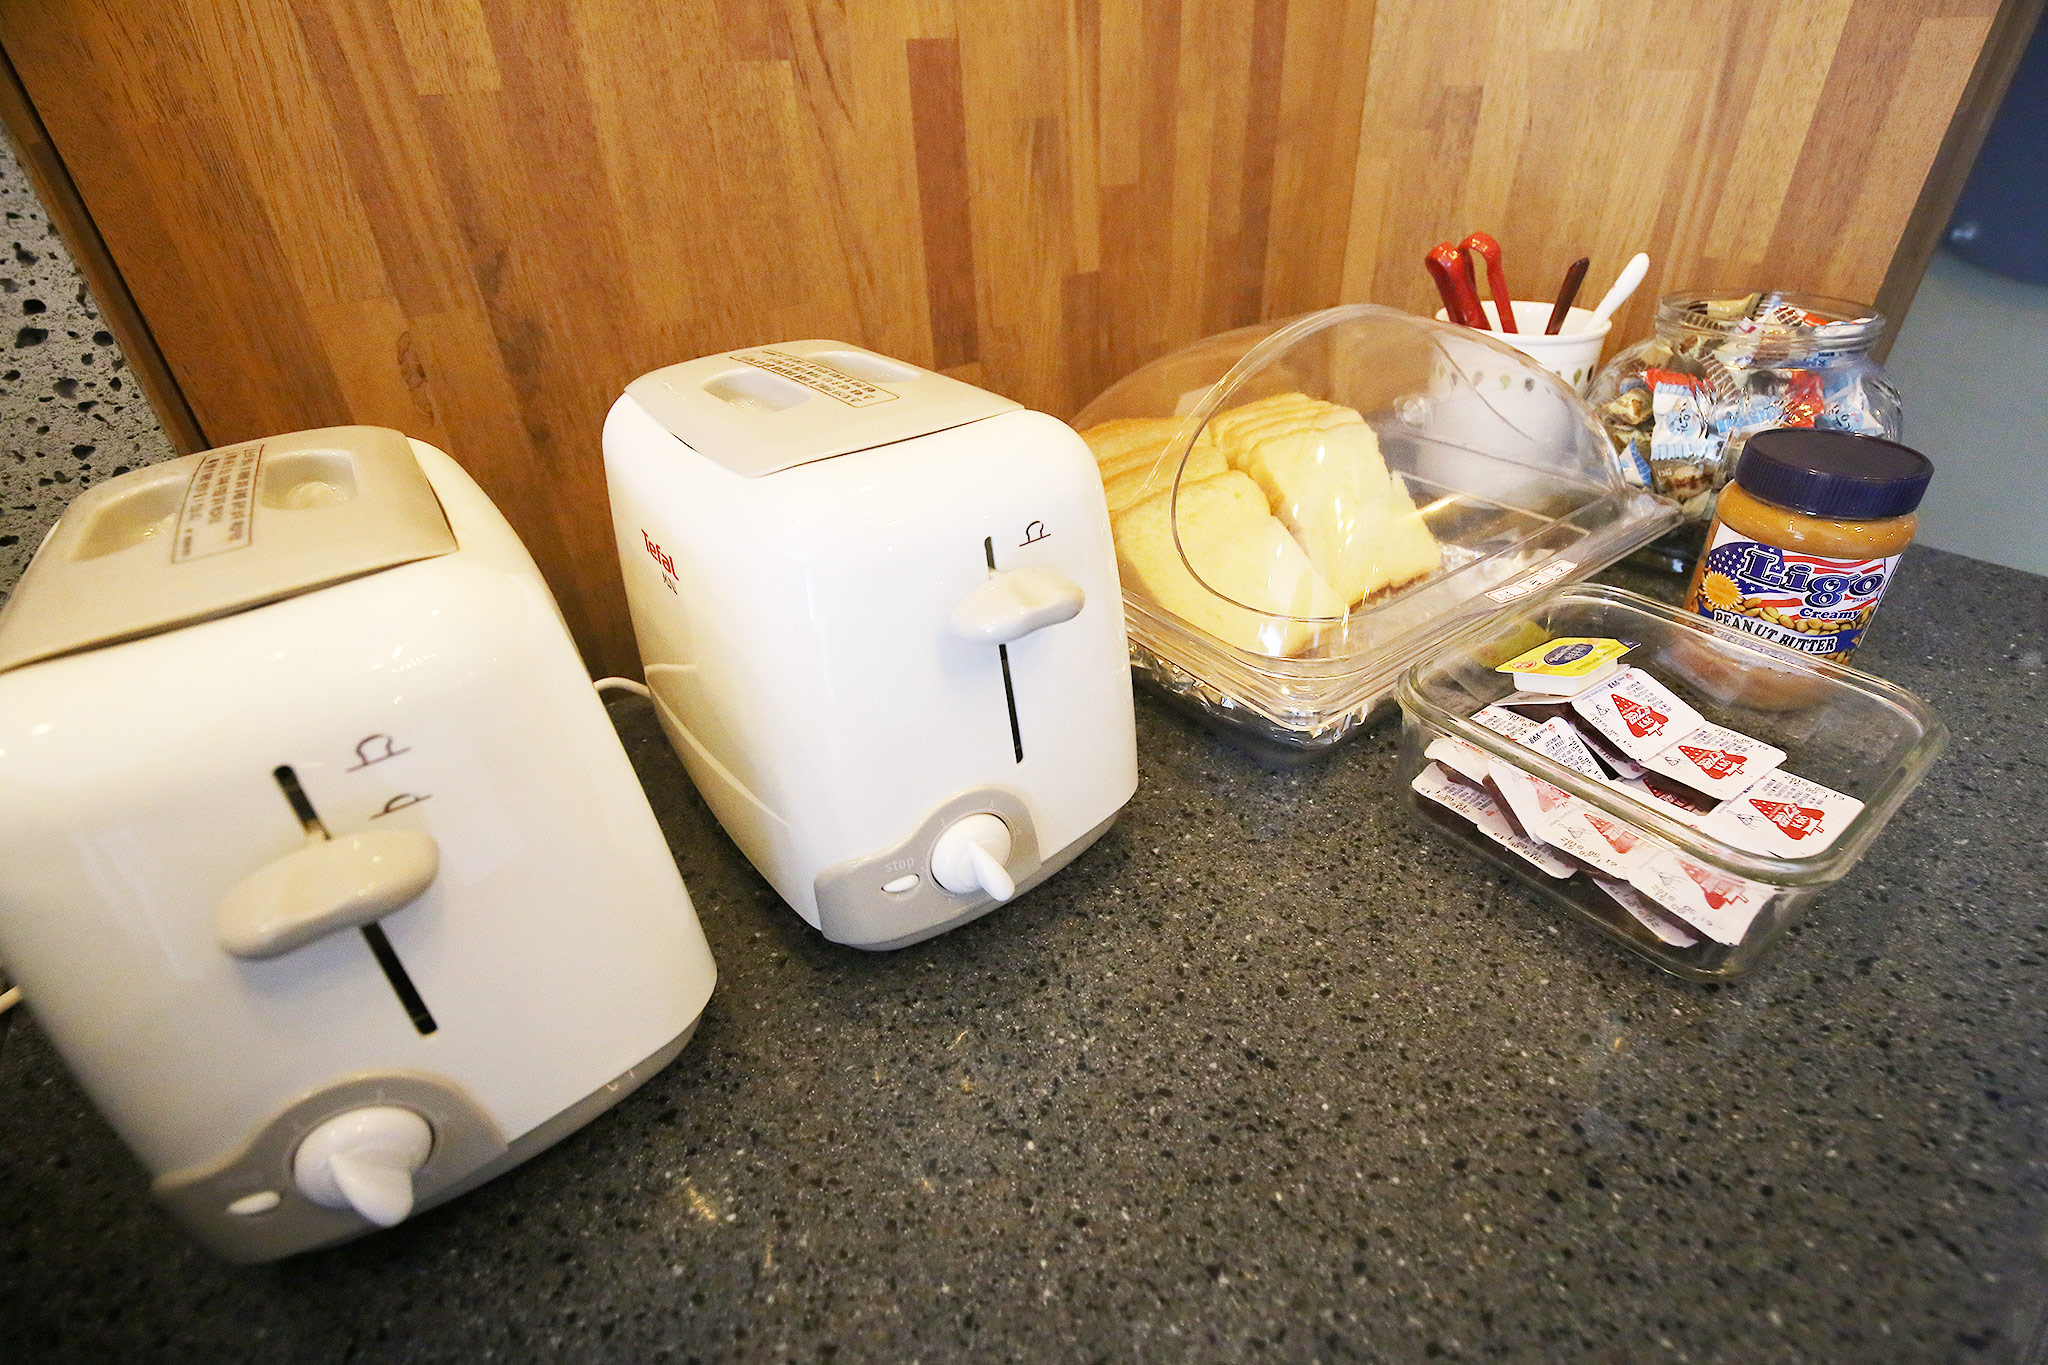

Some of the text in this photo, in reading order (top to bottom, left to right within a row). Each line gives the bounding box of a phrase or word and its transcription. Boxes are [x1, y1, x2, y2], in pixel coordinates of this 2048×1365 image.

[641, 528, 679, 581] Tefal
[1738, 548, 1884, 608] Ligo
[1715, 611, 1779, 641] PEANUT
[1779, 633, 1836, 653] BUTTER
[1799, 607, 1861, 621] Creamy
[885, 857, 915, 873] stop
